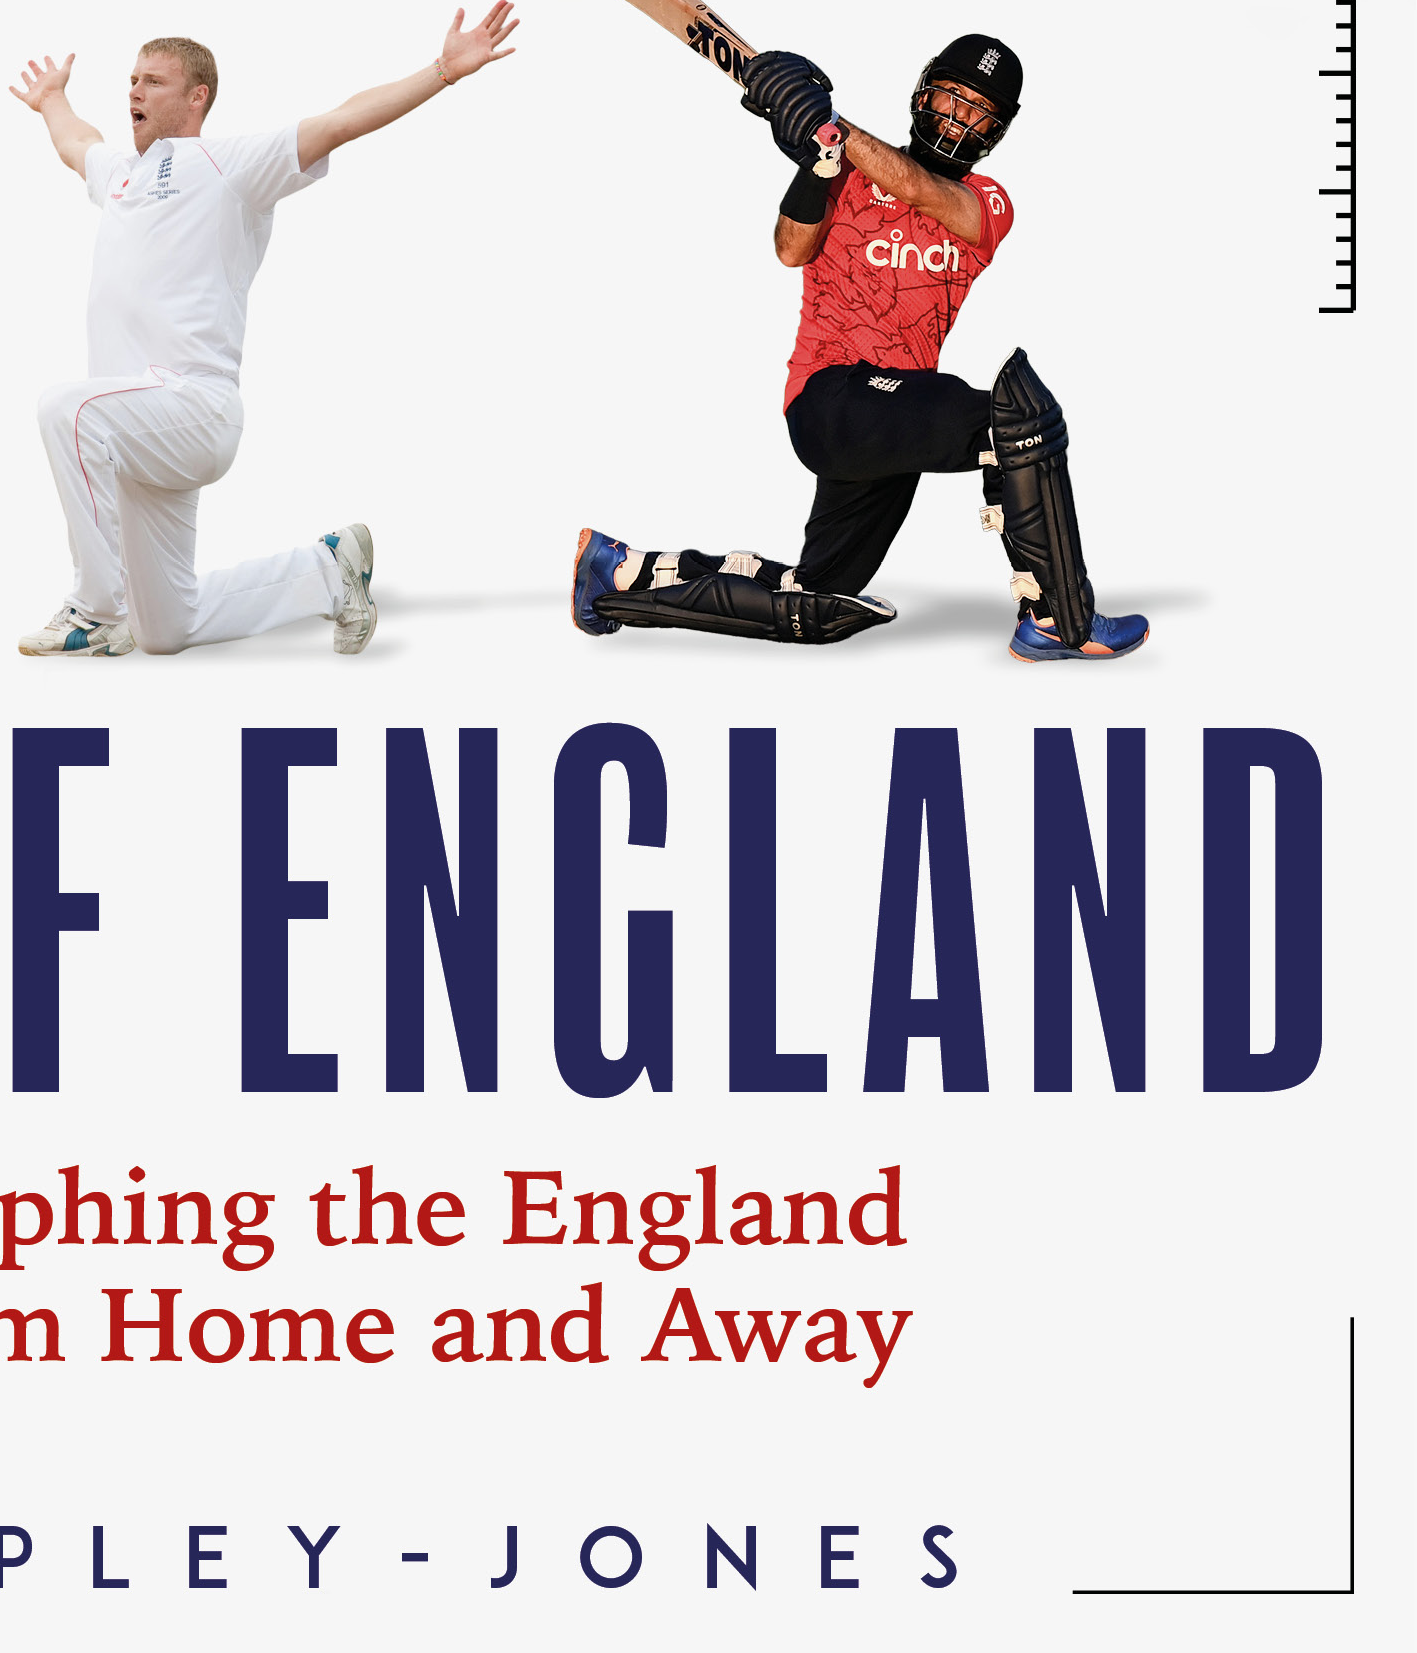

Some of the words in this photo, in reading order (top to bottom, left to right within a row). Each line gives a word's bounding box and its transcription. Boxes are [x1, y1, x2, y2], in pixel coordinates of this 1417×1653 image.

[982, 185, 1006, 215] IG
[866, 229, 960, 273] cinch
[1015, 434, 1043, 450] TON
[790, 613, 804, 638] TON
